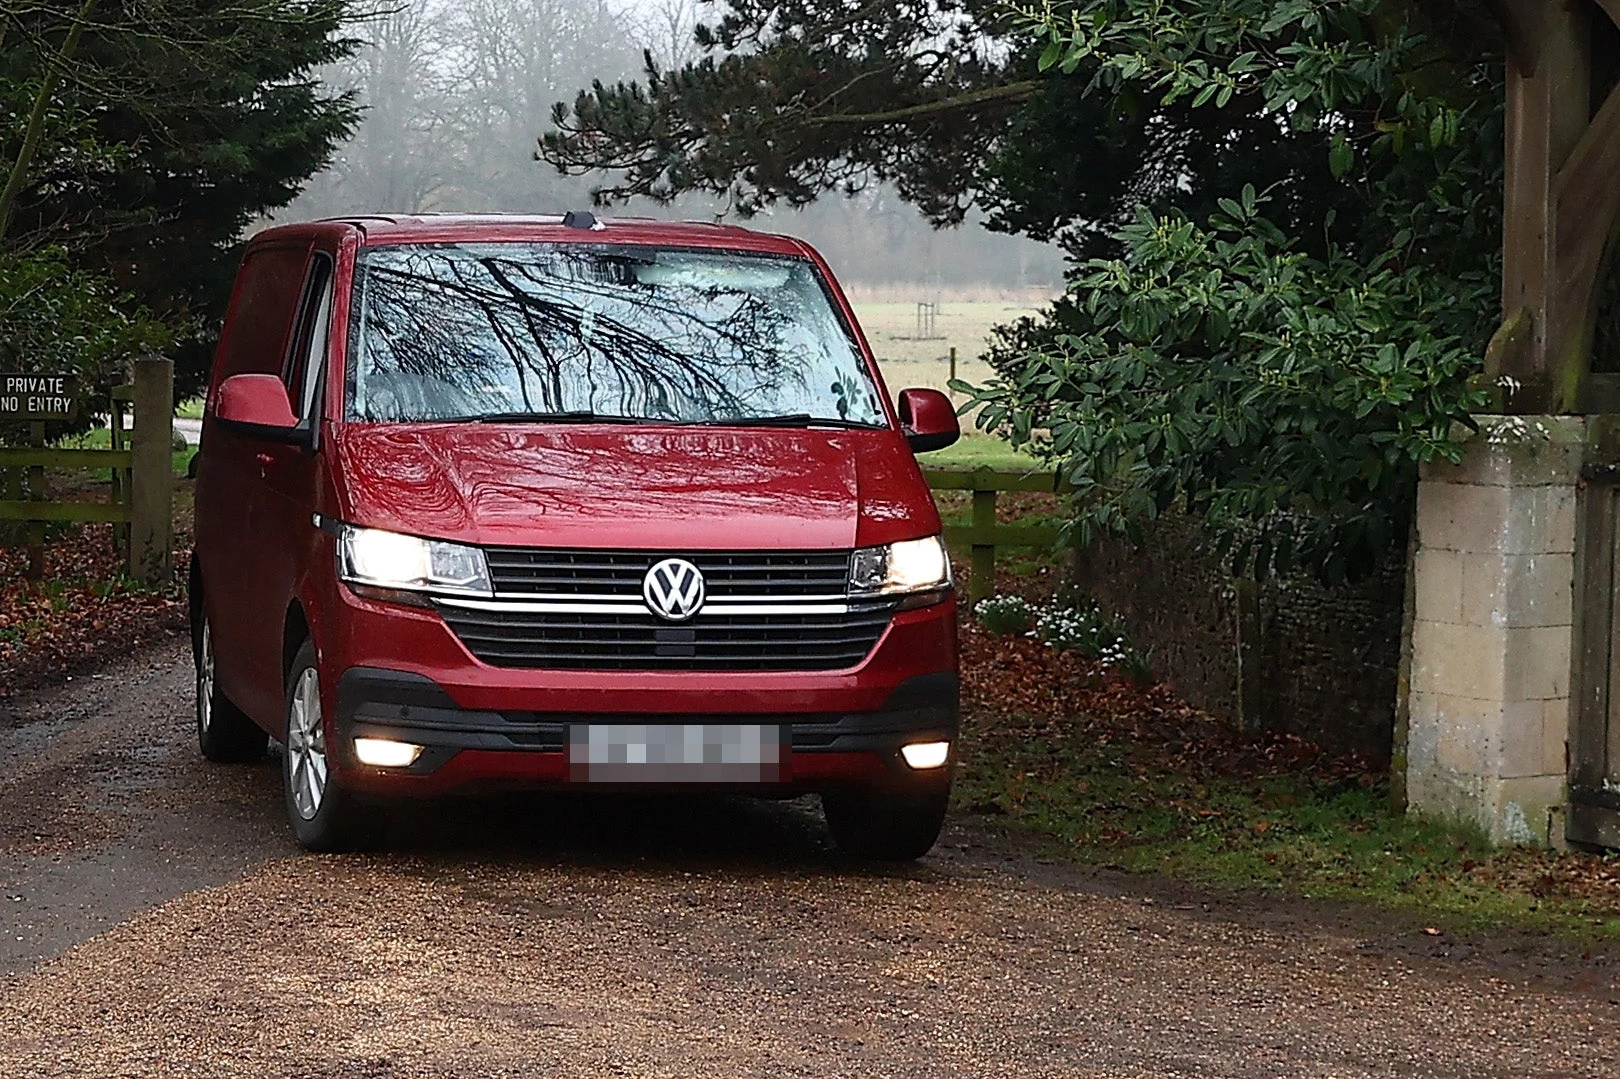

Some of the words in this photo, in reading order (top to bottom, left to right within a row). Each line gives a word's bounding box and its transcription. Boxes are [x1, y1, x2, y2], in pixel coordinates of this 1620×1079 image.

[6, 377, 64, 394] PRIVATE
[1, 396, 19, 412] NO
[28, 396, 72, 413] ENTRY
[644, 558, 705, 621] VW
